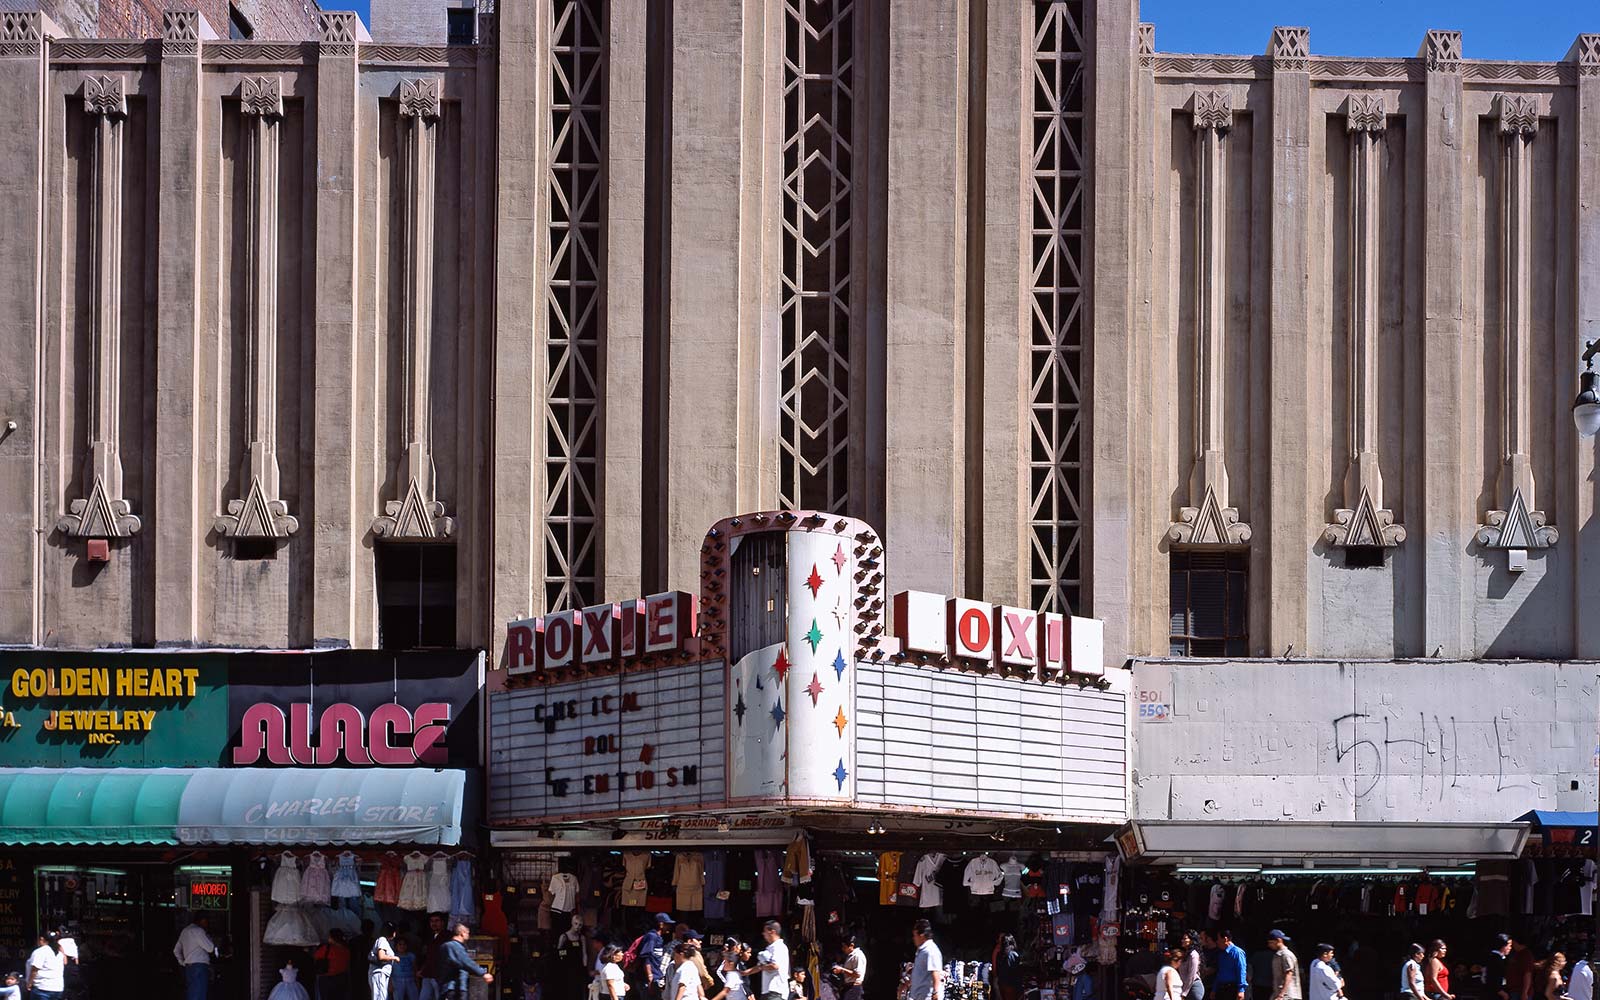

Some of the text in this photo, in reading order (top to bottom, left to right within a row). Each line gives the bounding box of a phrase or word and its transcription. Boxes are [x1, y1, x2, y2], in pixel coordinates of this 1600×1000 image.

[508, 598, 674, 670] ROXIE
[959, 608, 1064, 663] OXI
[12, 668, 200, 698] GOLDEN HEART
[1139, 691, 1163, 702] 501
[43, 710, 157, 731] JEWELRY
[88, 732, 121, 745] INC.
[244, 795, 439, 825] CHARLES STORE
[735, 817, 761, 827] LARGE
[192, 883, 228, 897] MAYOREO
